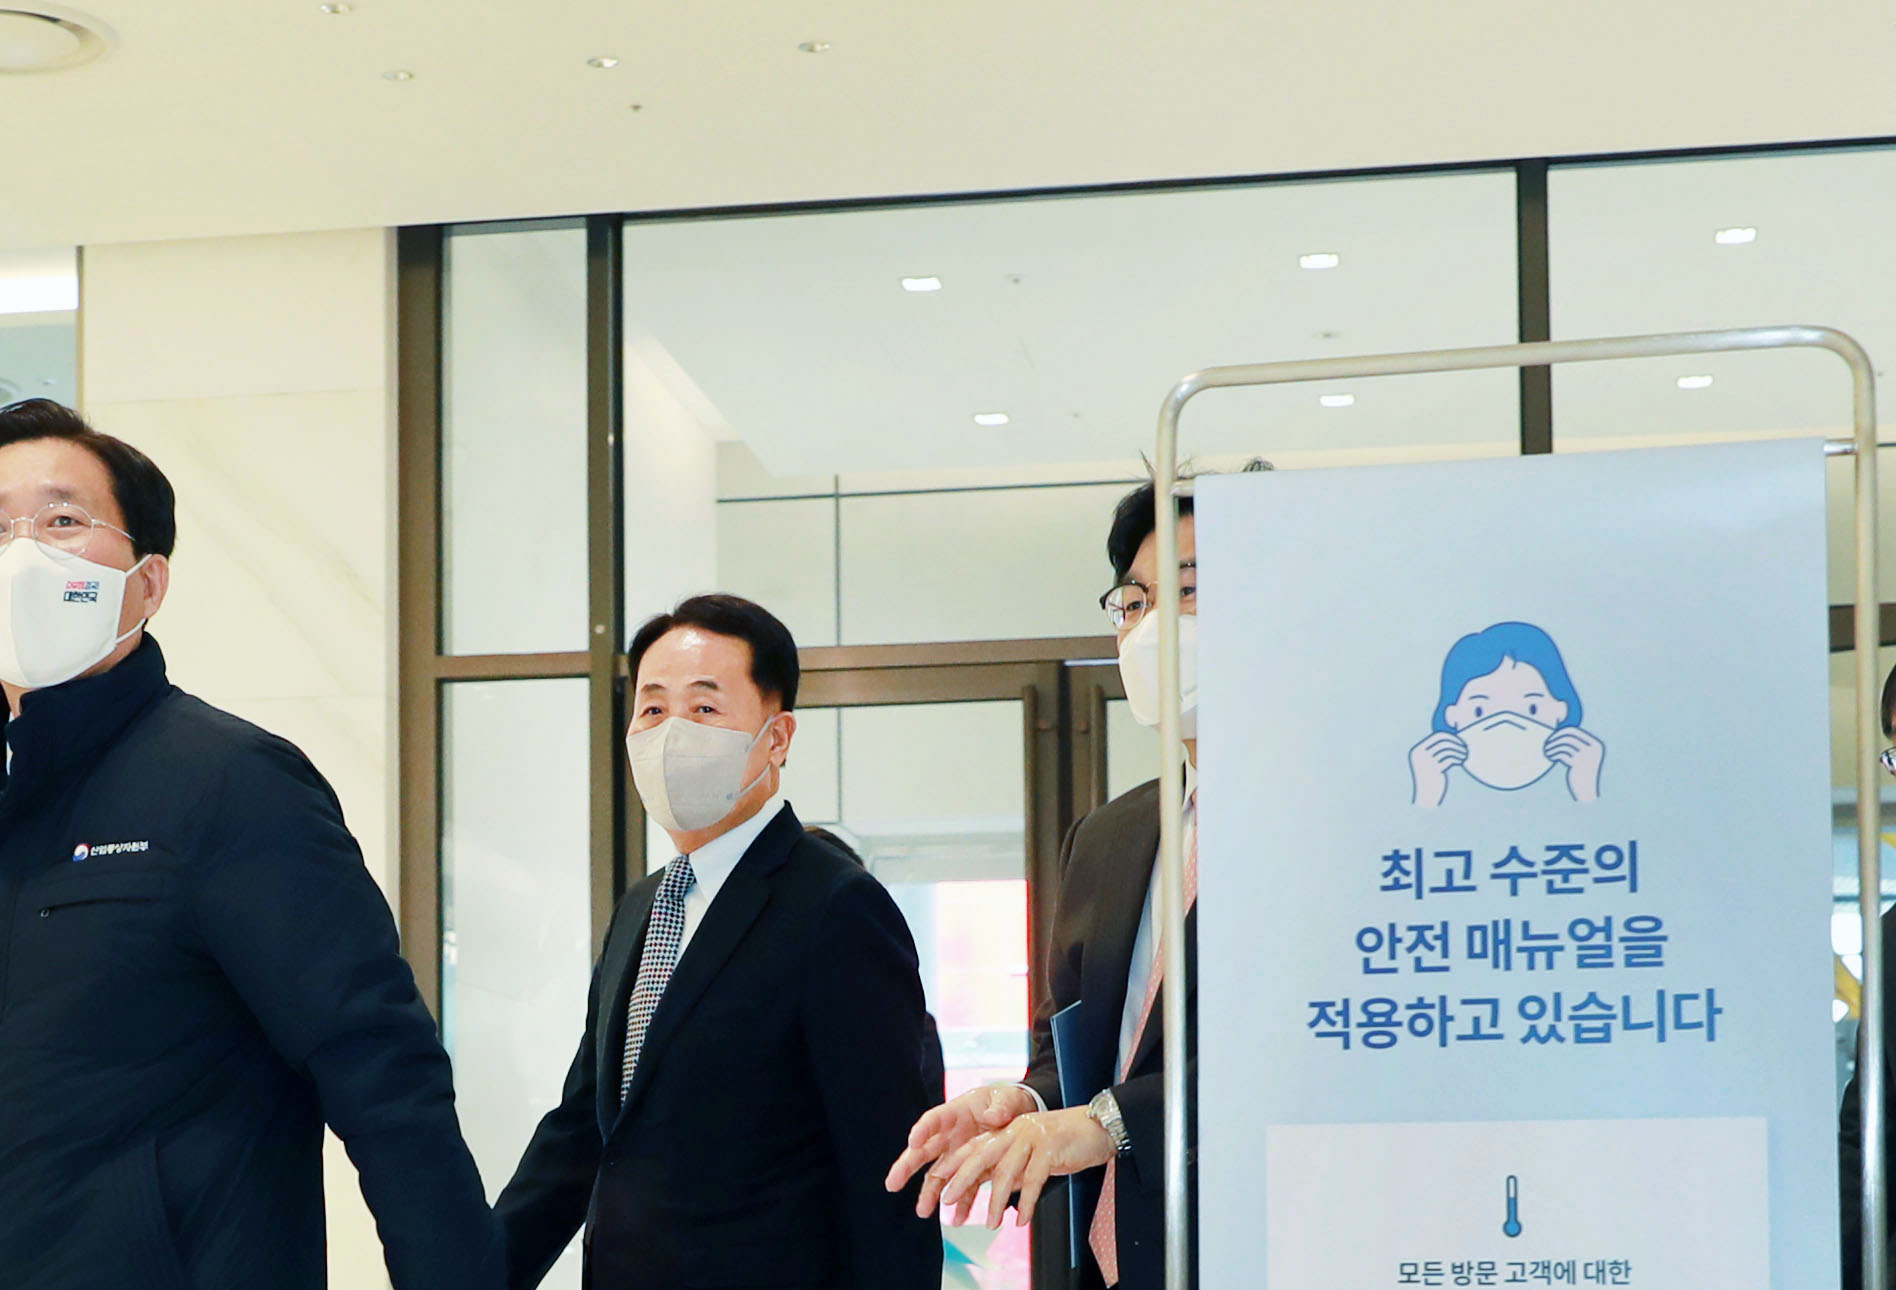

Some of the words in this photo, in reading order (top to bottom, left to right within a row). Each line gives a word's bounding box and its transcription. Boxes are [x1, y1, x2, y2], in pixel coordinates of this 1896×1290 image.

[1379, 847, 1478, 901] 최고
[1489, 839, 1638, 897] 수준의
[1355, 920, 1451, 975] 안전
[1466, 915, 1669, 972] 매뉴얼을
[1307, 994, 1505, 1051] 적용하고
[1517, 987, 1724, 1045] 있습니다
[1397, 1261, 1445, 1287] 모든
[1451, 1260, 1499, 1287] 방문
[1503, 1259, 1577, 1286] 고객에
[1583, 1259, 1633, 1286] 대한
